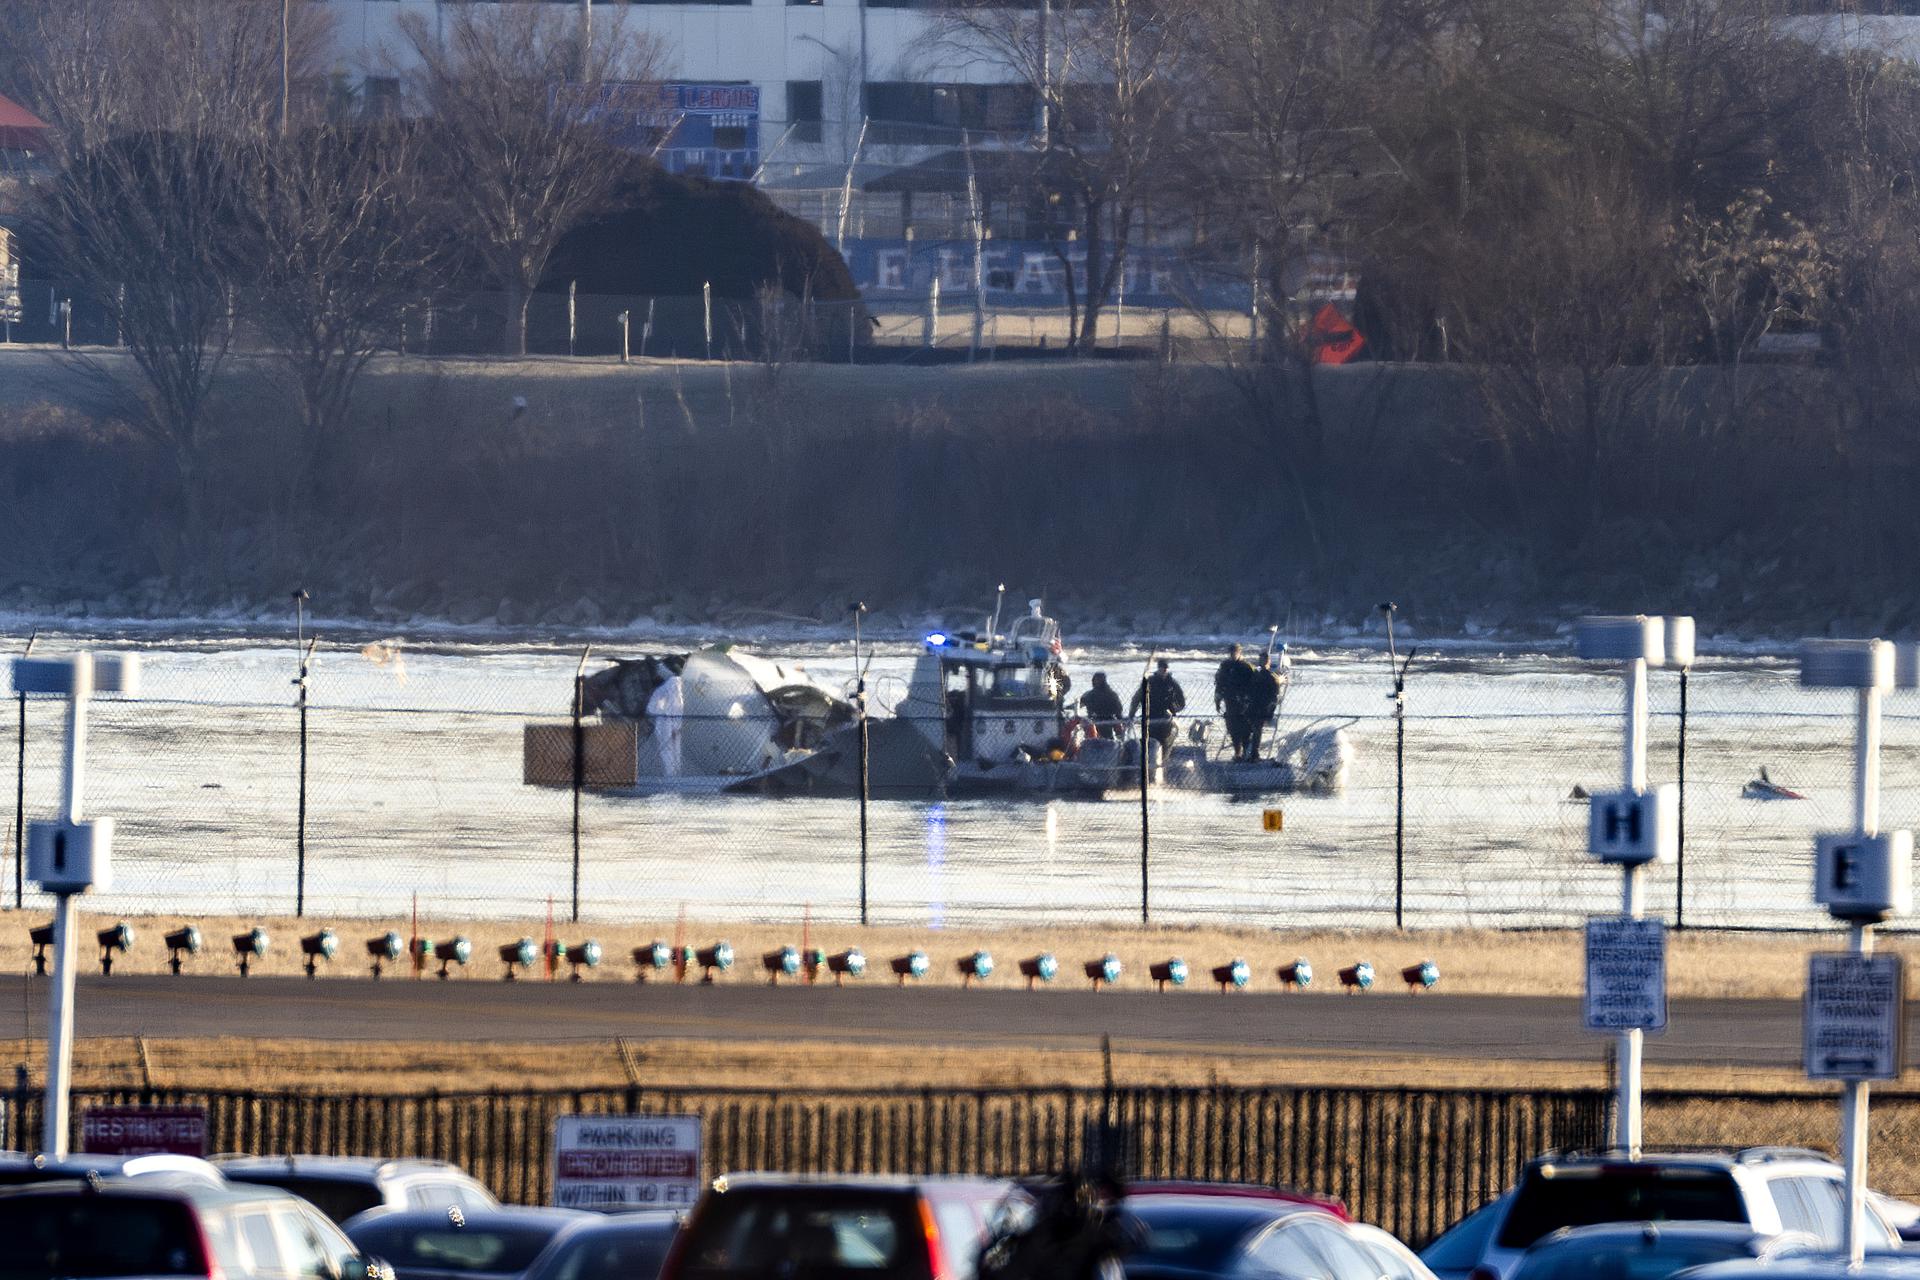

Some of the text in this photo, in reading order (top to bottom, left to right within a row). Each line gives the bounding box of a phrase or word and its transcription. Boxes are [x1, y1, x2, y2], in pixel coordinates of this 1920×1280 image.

[1605, 804, 1642, 843] H
[1834, 846, 1858, 891] E
[84, 1117, 204, 1138] RESTRICTED
[576, 1125, 677, 1147] PARKING
[568, 1152, 689, 1173] PROHIBITED
[557, 1183, 626, 1203] WITHIN
[667, 1184, 692, 1203] FT
